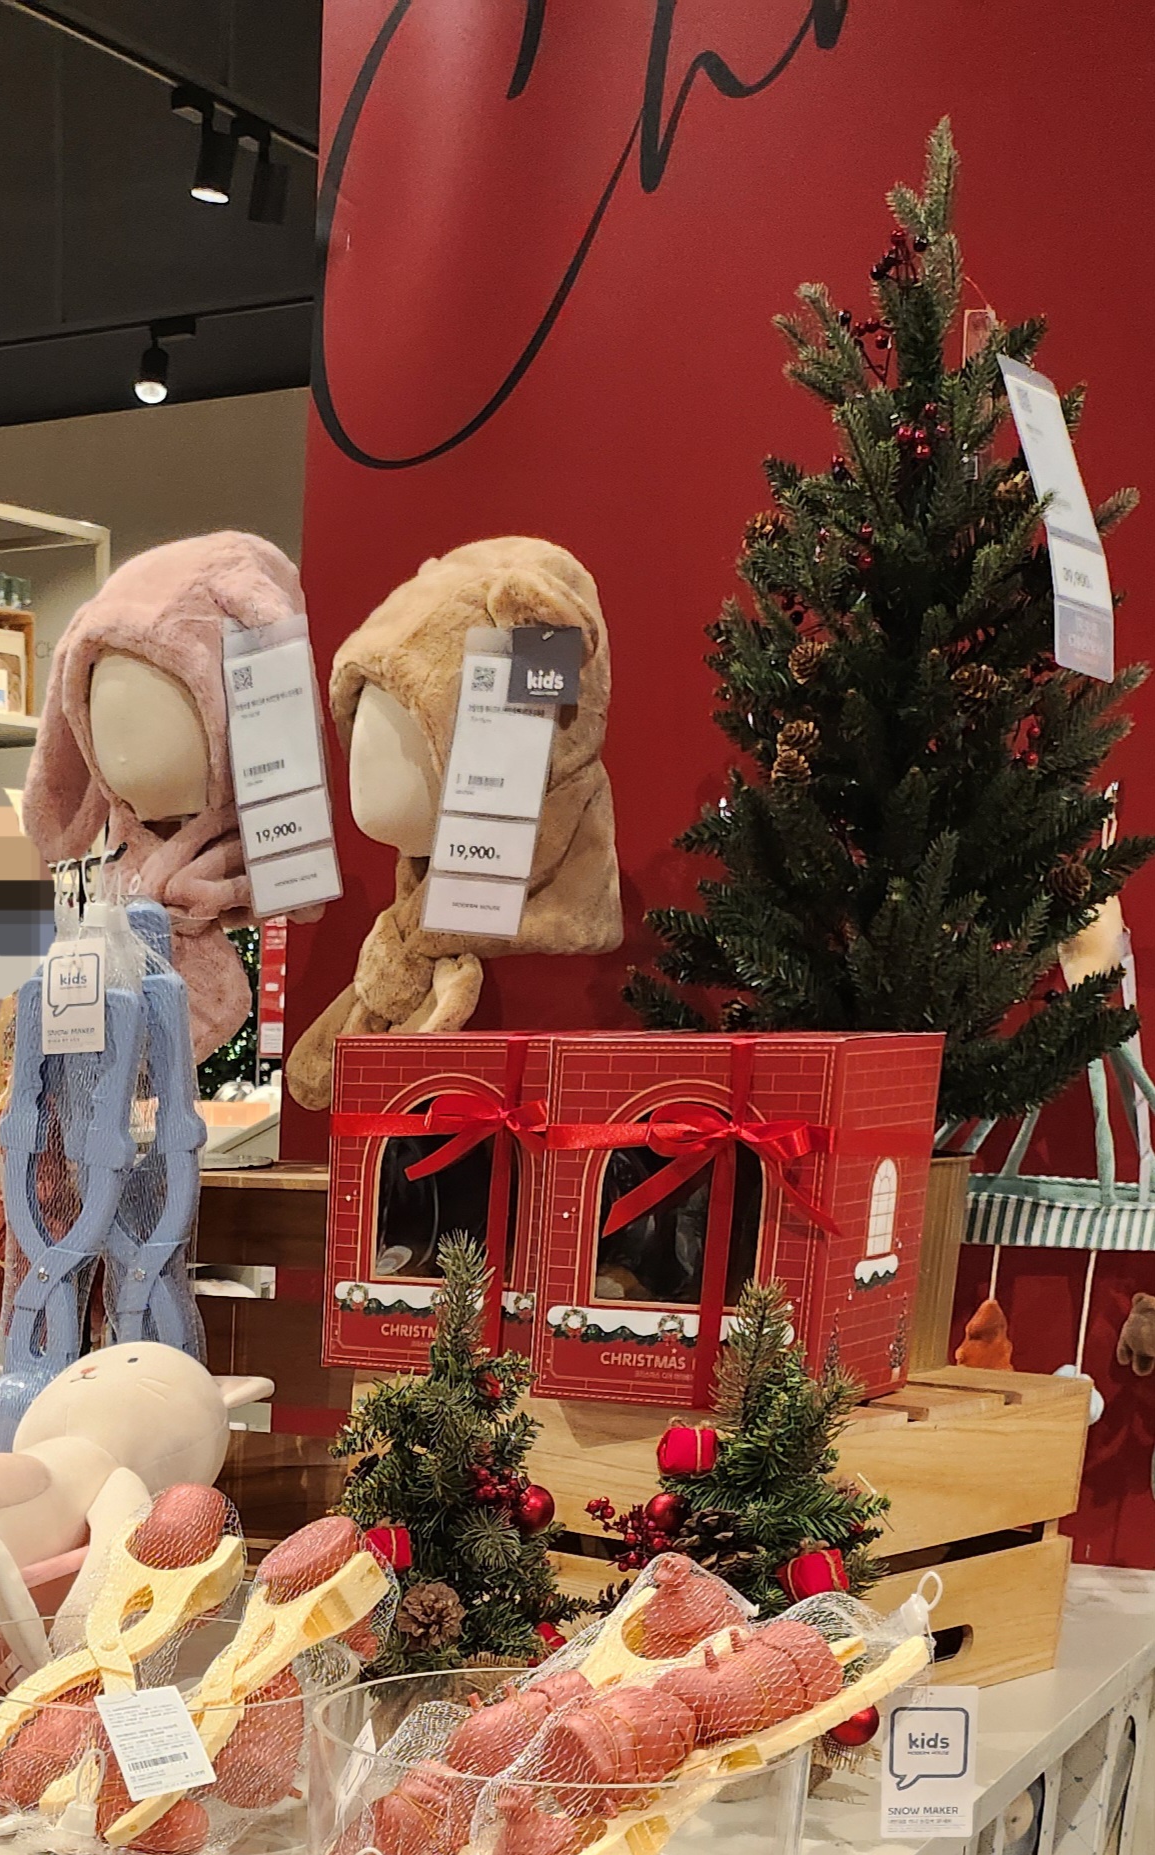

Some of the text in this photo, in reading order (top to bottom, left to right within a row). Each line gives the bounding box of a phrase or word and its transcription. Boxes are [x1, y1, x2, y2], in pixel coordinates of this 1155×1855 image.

[526, 669, 564, 690] kids
[255, 821, 297, 844] 19,900
[449, 843, 496, 861] 19,900
[59, 970, 88, 986] kids
[380, 1323, 438, 1339] CHRISTM
[599, 1351, 687, 1371] CHRISTMAS
[908, 1732, 950, 1750] kids
[887, 1806, 959, 1816] SNOW MAKER
